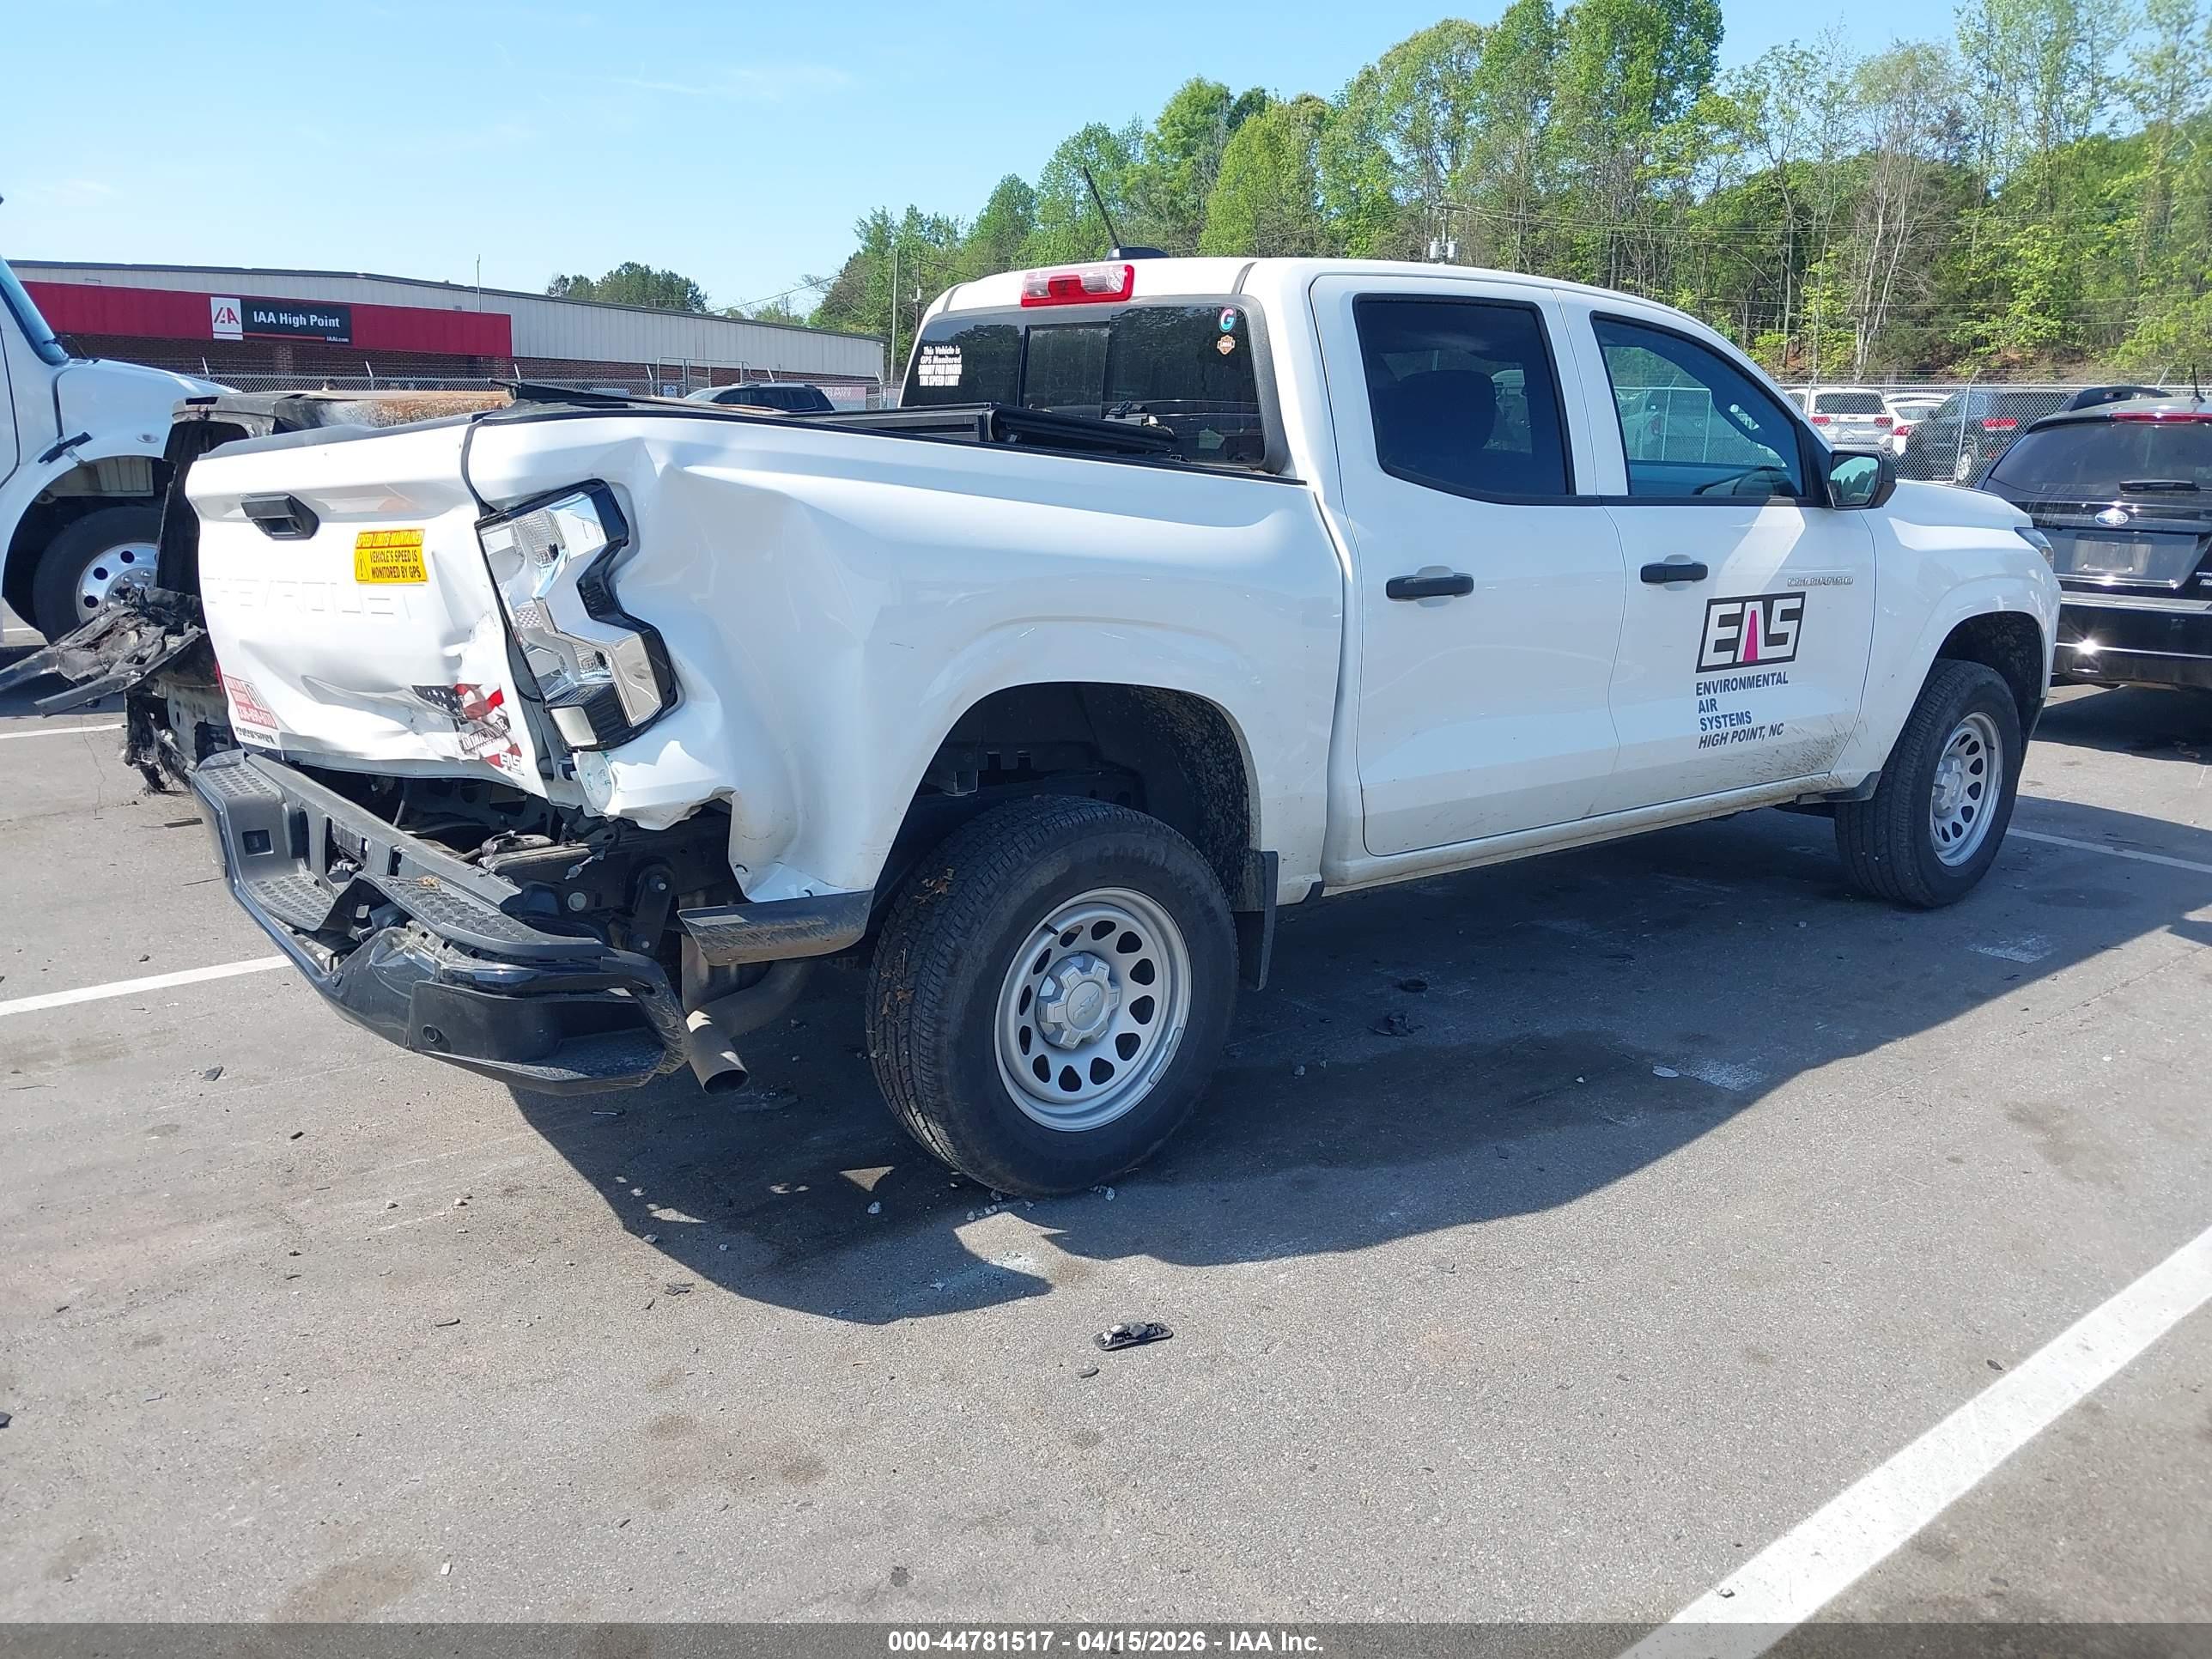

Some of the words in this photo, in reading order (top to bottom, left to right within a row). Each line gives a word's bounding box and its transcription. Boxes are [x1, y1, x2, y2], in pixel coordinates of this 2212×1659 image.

[253, 311, 276, 325] IAA
[279, 313, 307, 328] High
[310, 315, 341, 328] Point
[923, 345, 934, 355] This
[935, 344, 955, 355] Vehicle
[955, 344, 961, 354] is
[920, 355, 933, 364] GPS
[933, 354, 962, 364] Monitored
[370, 550, 393, 563] VEHICLE'S
[394, 550, 410, 562] SPEED
[412, 549, 418, 562] IS
[371, 566, 400, 579] MONITORED
[401, 566, 408, 578] BY
[409, 565, 421, 578] GPS
[1696, 672, 1789, 696] ENVIRONMENTAL
[1698, 697, 1717, 714] AIR
[1700, 710, 1752, 732] SYSTEMS
[1698, 732, 1729, 749] HIGH
[1730, 726, 1765, 744] POINT,
[1768, 722, 1784, 737] NC
